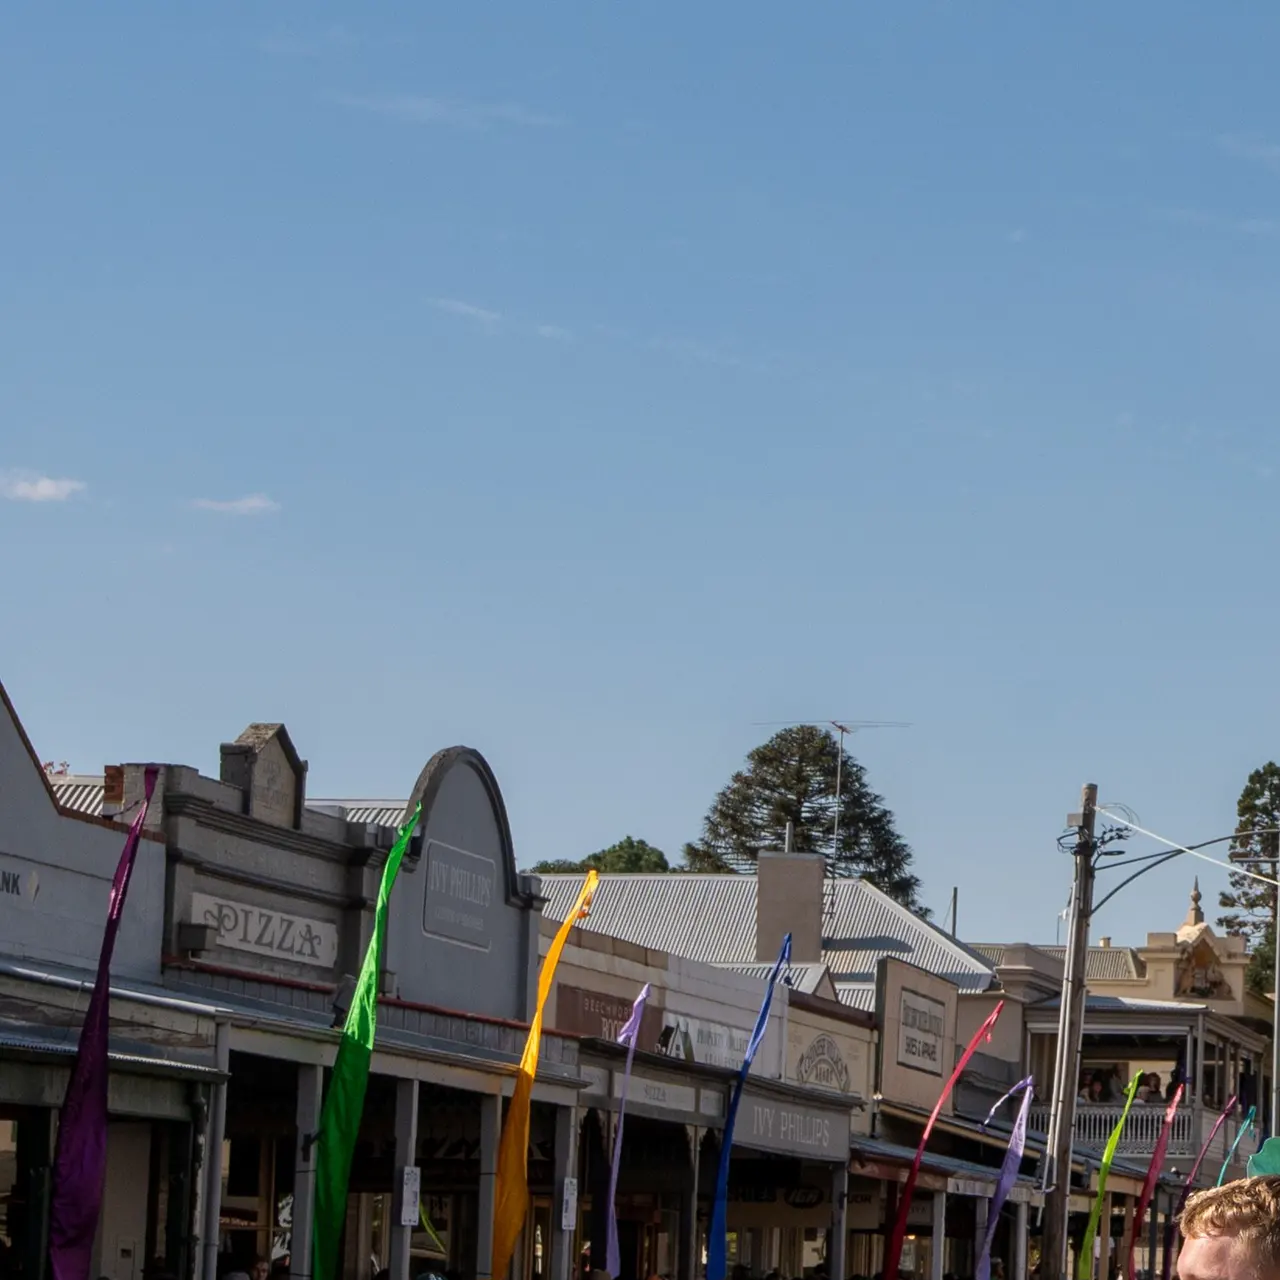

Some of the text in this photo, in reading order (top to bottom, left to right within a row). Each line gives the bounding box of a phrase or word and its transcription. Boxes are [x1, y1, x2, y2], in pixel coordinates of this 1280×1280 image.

[204, 902, 322, 959] PIZZA
[753, 1105, 830, 1148] IVY PHILLIPS
